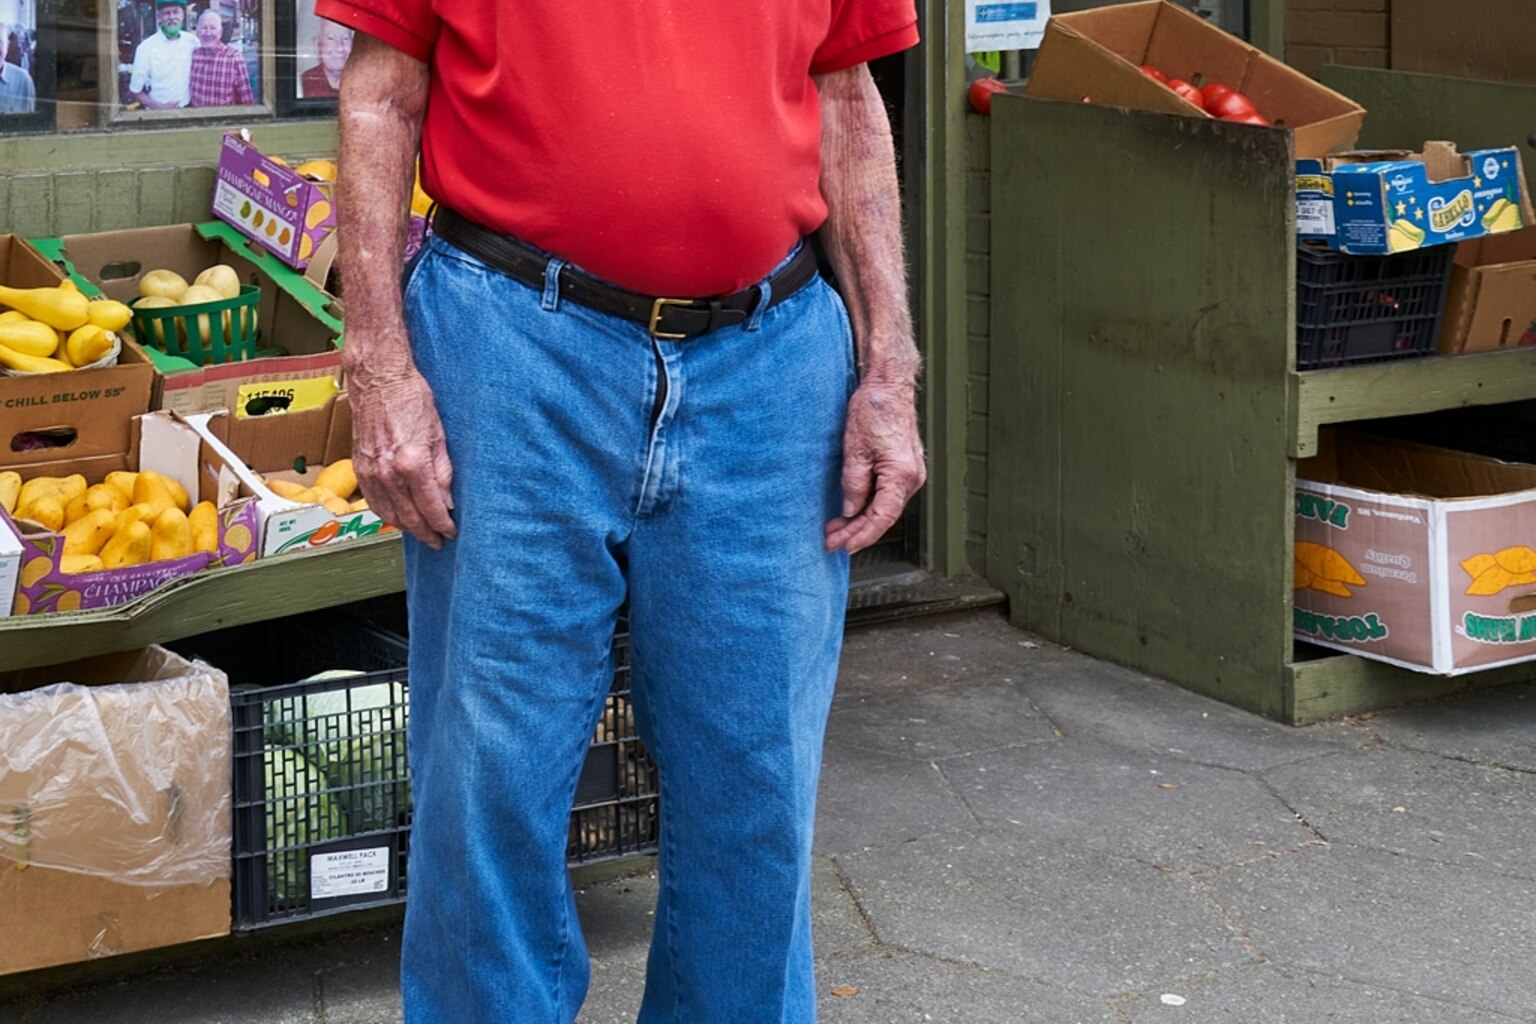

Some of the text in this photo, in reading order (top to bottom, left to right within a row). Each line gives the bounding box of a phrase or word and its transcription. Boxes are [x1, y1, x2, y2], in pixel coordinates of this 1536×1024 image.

[219, 166, 266, 203] CHAMPAGNE
[5, 396, 48, 408] CHILL
[52, 389, 101, 404] BELOW
[104, 386, 126, 398] 55°
[1364, 549, 1411, 568] Quality
[1360, 562, 1417, 584] Premium
[1464, 612, 1517, 643] FARMS
[327, 853, 357, 861] MAXWELL
